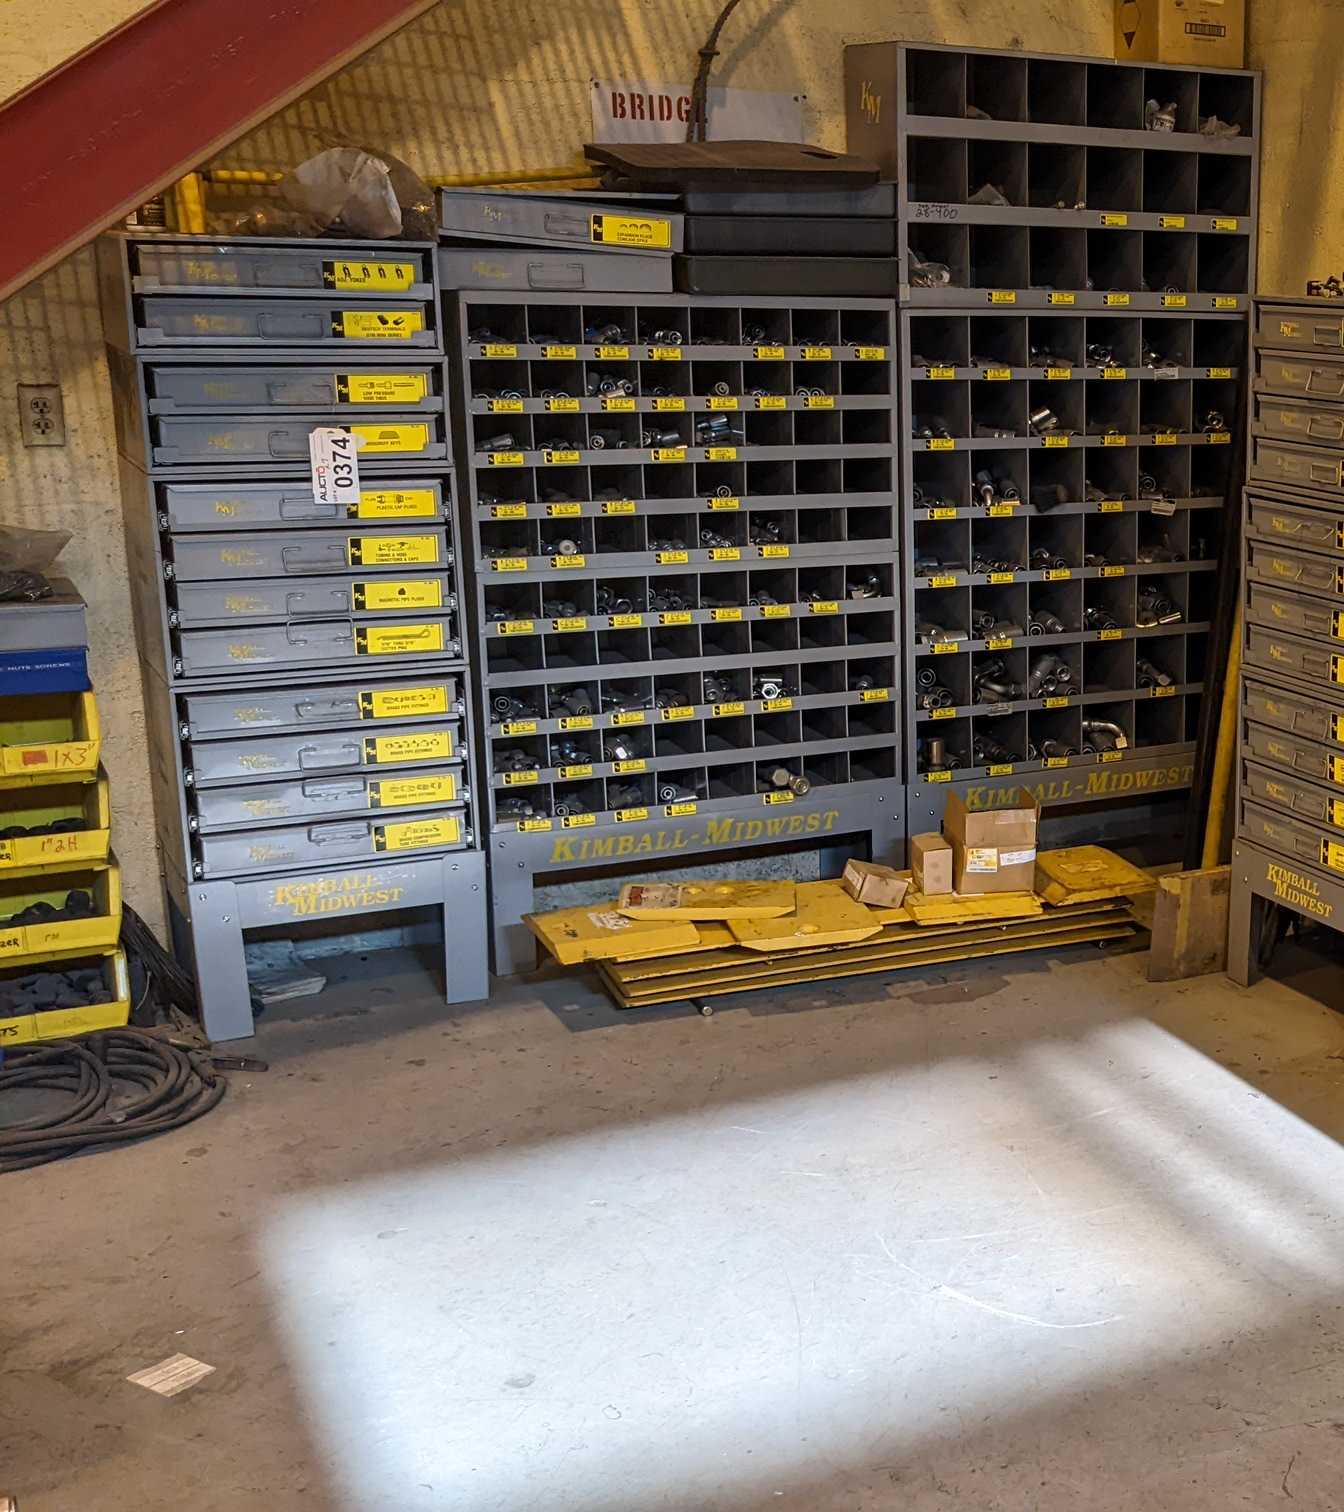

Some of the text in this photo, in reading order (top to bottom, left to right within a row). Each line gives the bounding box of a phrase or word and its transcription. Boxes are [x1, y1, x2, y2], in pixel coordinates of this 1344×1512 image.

[330, 437, 354, 488] 0374
[965, 765, 1195, 809] KIMALL-MIDWEST
[1267, 863, 1320, 896] KIMBALL
[1273, 879, 1333, 918] MIDWEST
[293, 886, 404, 916] MIDWEST
